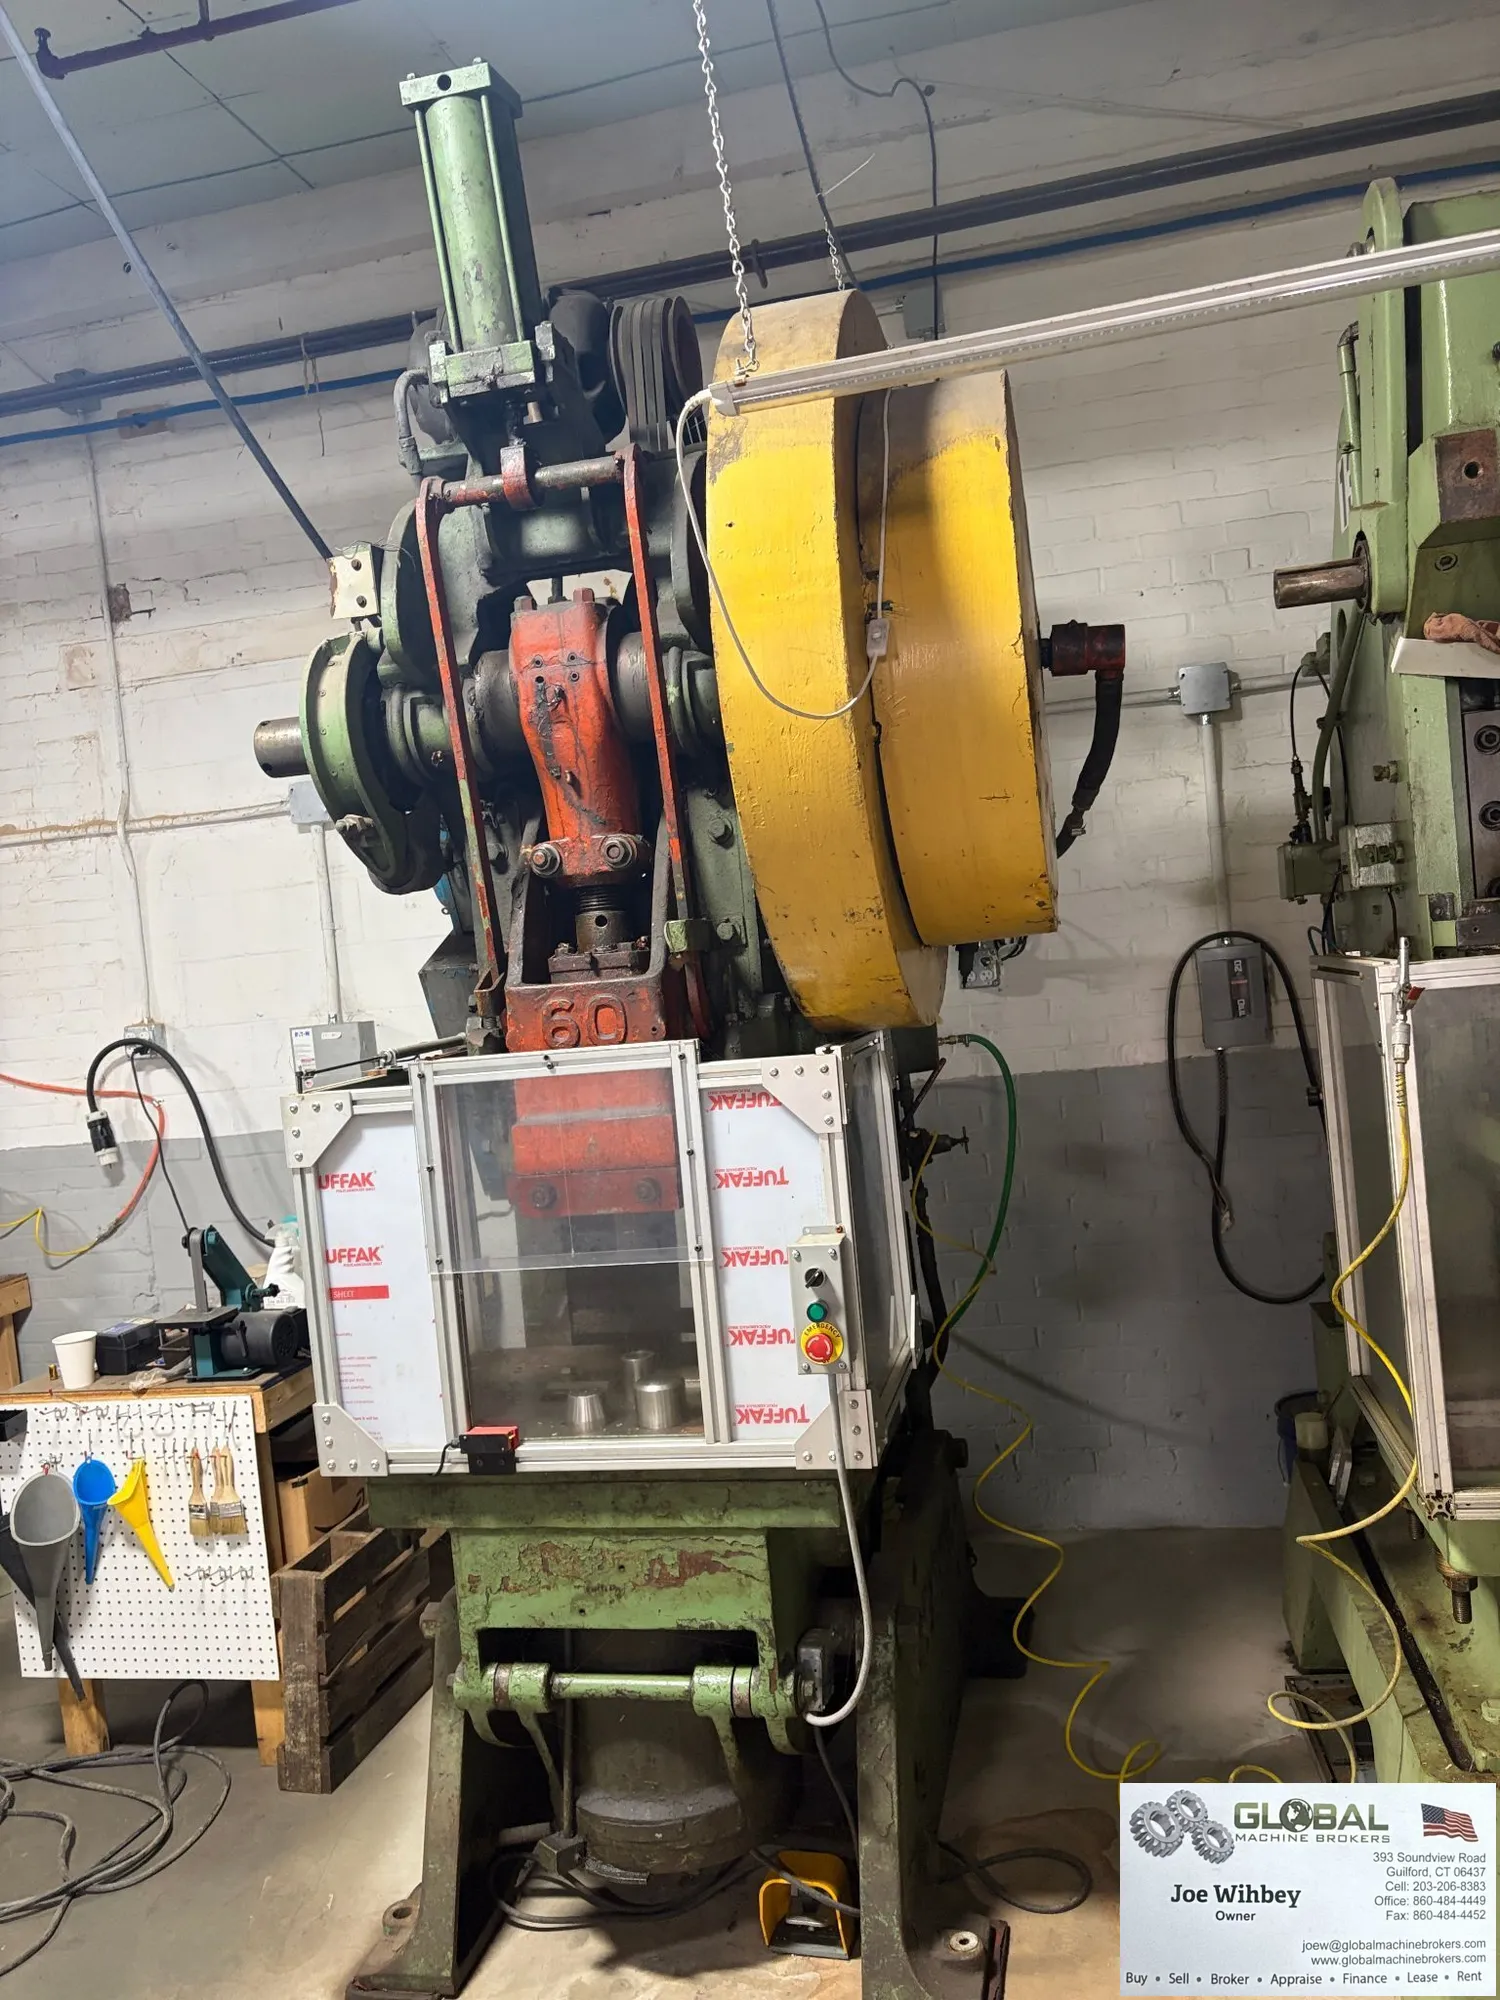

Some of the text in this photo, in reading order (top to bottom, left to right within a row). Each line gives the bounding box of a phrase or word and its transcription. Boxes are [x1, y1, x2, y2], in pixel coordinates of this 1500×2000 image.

[541, 993, 628, 1050] 60
[318, 1172, 375, 1189] UFFAK
[715, 1166, 789, 1188] TUFFAK
[326, 1246, 381, 1263] UFFAK
[804, 1322, 841, 1338] EMERGENCY
[736, 1404, 810, 1424] TUFFAK
